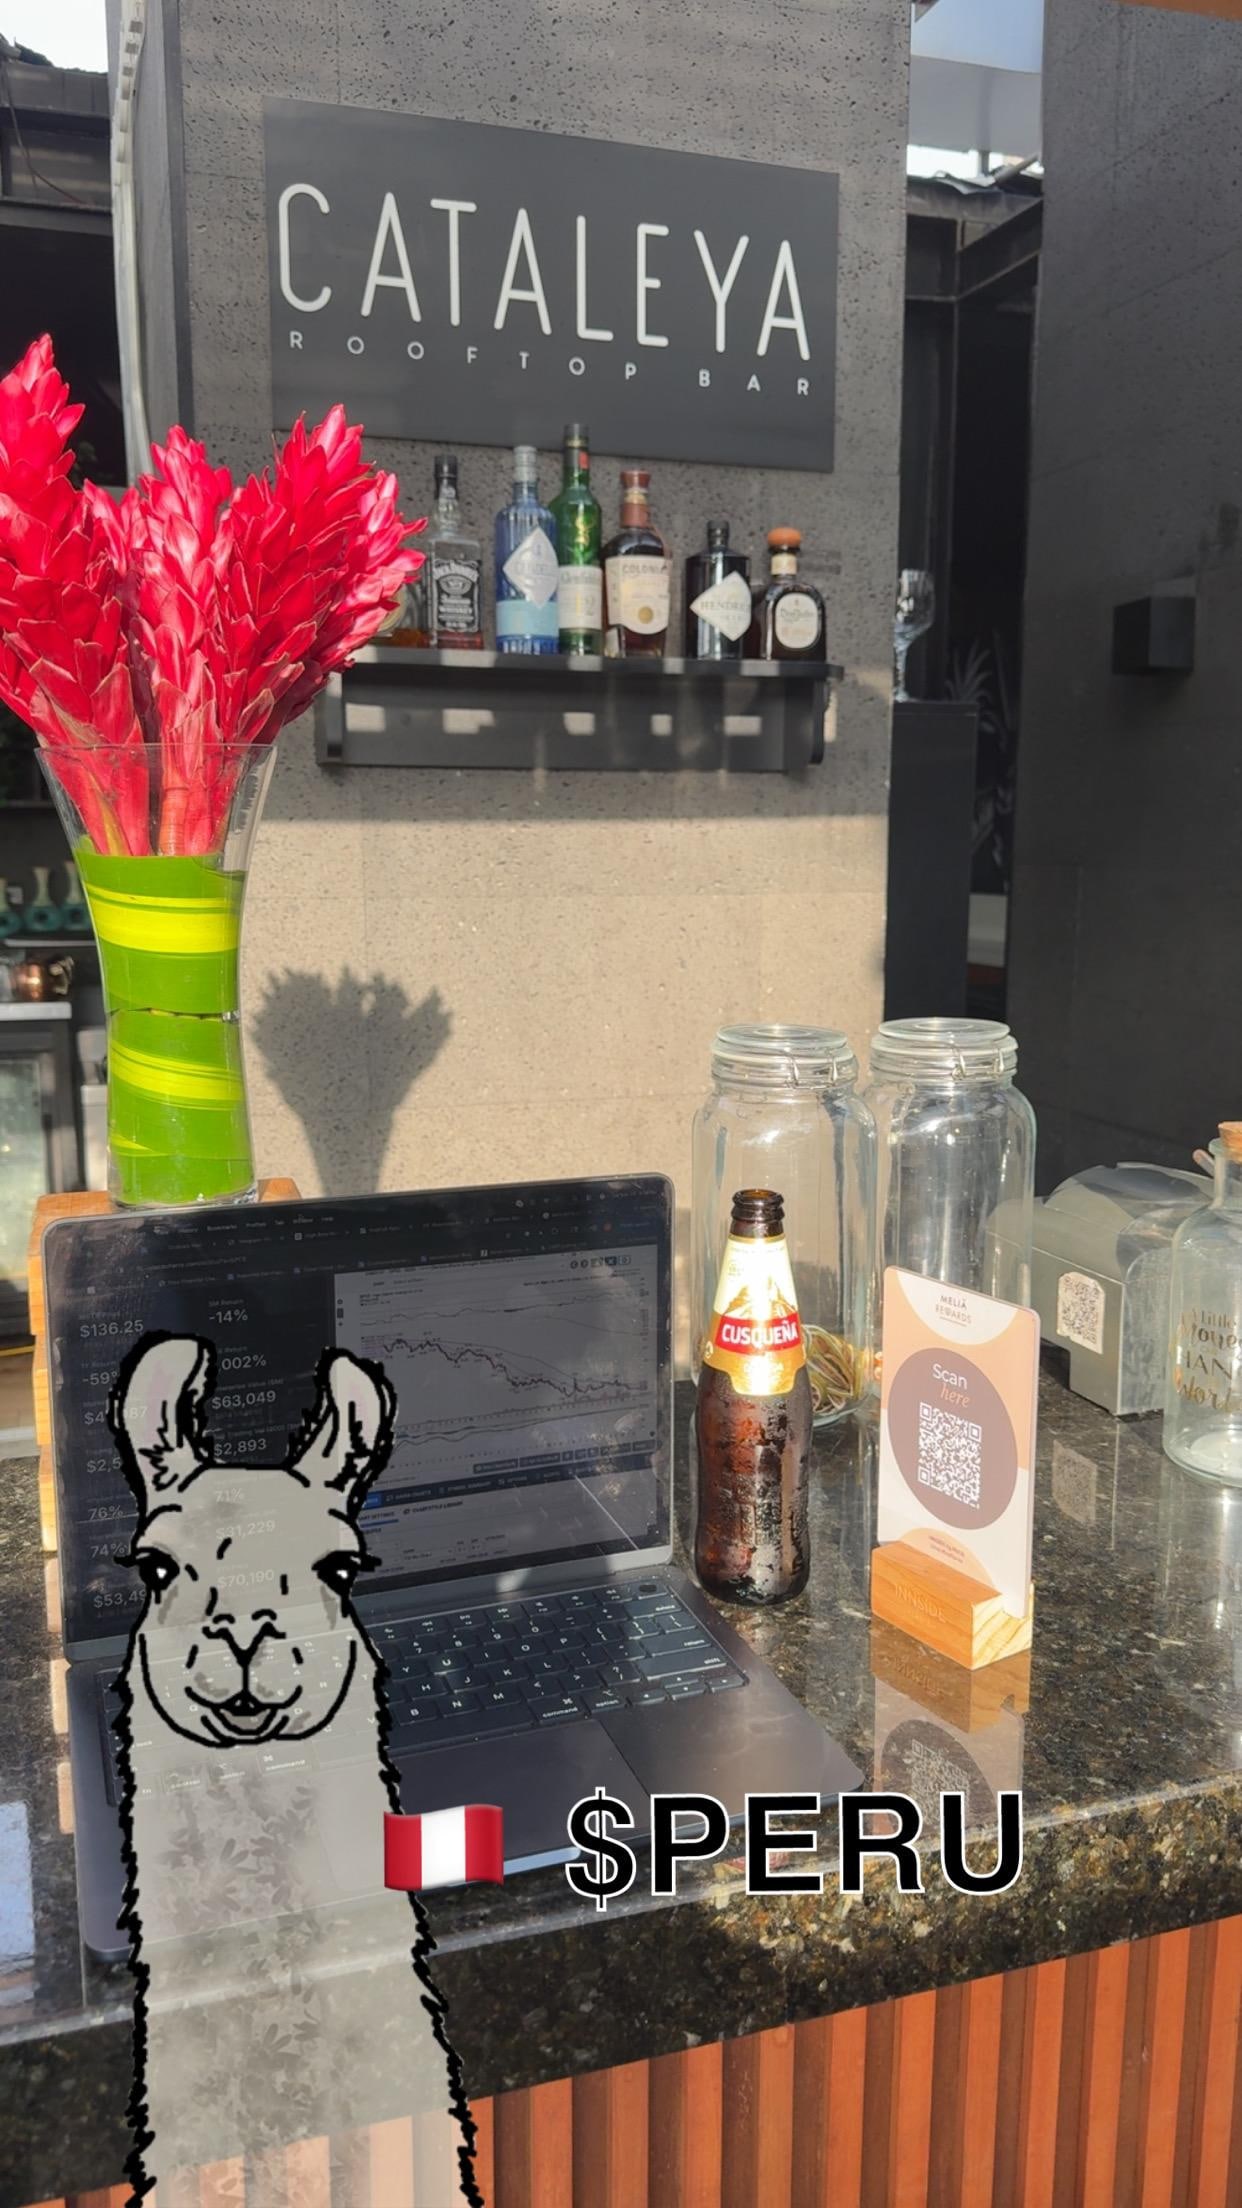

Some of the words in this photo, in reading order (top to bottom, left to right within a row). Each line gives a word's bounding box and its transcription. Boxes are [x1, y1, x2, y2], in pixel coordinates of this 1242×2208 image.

[278, 183, 811, 361] CATALEYA
[289, 330, 637, 380] ROOFTOP
[699, 368, 810, 396] BAR
[208, 1308, 249, 1324] -14%
[79, 1319, 145, 1339] $136.25
[721, 1319, 798, 1348] CUSQUEÑA
[932, 1362, 969, 1391] Scan
[211, 1389, 277, 1410] $63,049
[940, 1383, 972, 1408] here
[213, 1437, 268, 1458] $2,893
